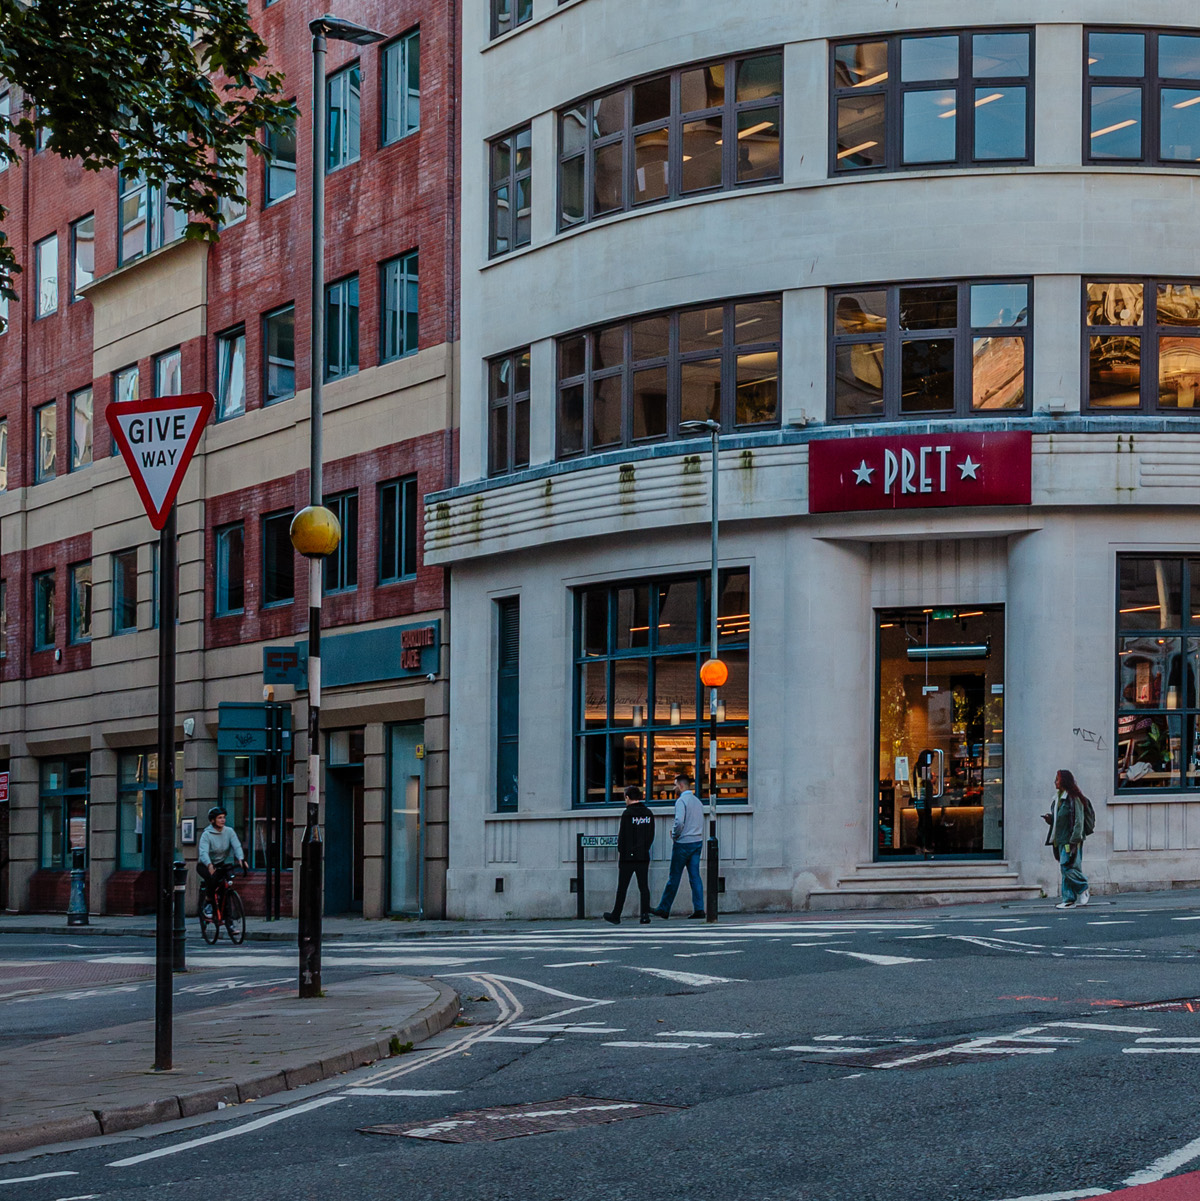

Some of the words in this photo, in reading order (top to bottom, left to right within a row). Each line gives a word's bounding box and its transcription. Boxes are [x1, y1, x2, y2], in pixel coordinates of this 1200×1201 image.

[129, 415, 186, 444] GIVE
[142, 449, 177, 468] WAY
[884, 446, 951, 494] PRET
[632, 816, 651, 825] Hybrid
[583, 837, 599, 845] QUEEN
